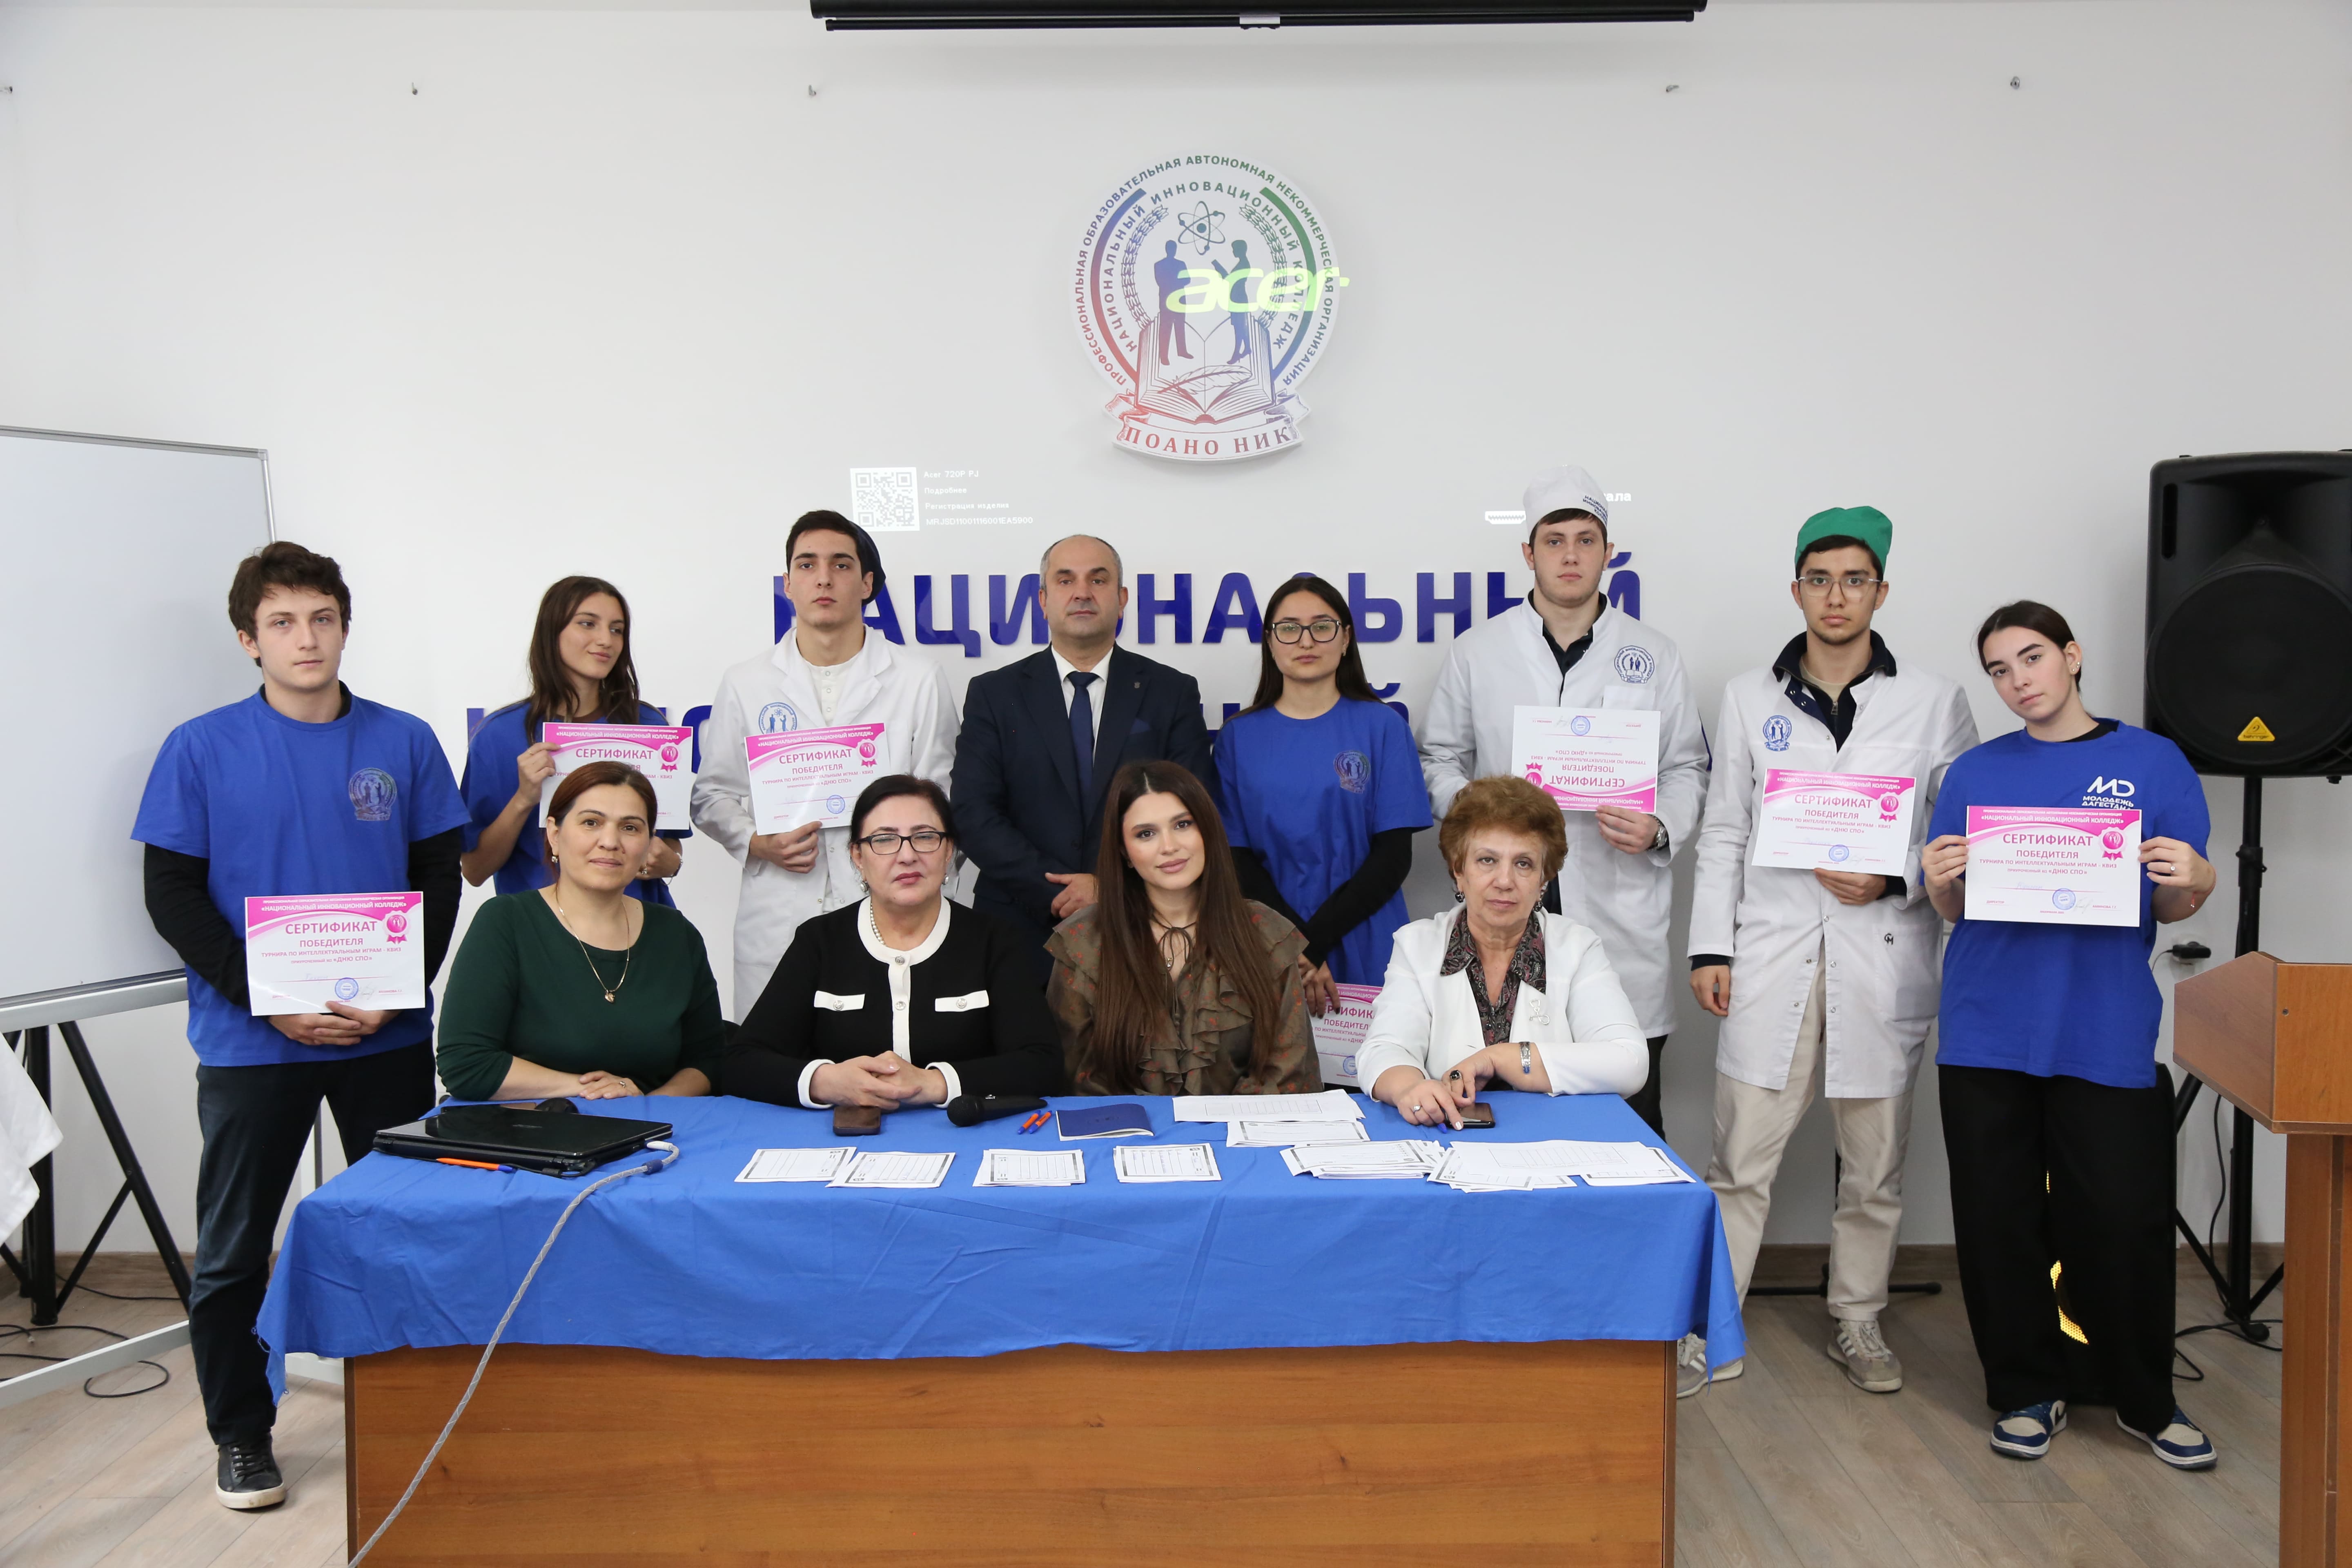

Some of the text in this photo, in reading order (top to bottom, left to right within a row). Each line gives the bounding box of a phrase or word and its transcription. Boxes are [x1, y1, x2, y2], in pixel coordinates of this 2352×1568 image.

[1075, 155, 1334, 386] ПРОФЕССИОНАЛЬНАЯ ОБРАЗОВАТЕЛЬНАЯ АВТОНОМНАЯ НЕКОММЕРЧЕСКАЯ ОРГАНИЗАЦИЯ
[1104, 181, 1304, 352] НАЦИОНАЛЬНЫЙ ИННОВАЦИОННЫЙ КОЛЛЕДЖ
[1165, 267, 1350, 314] acer
[1124, 425, 1291, 455] ПОАНО НИК
[758, 737, 802, 746] «НАЦИОНАЛЬНЫЙ
[803, 733, 847, 742] ИННОВАЦИОННЫЙ
[576, 748, 653, 759] СЕРТИФИКАТ
[779, 748, 852, 764] СЕРТИФИКАТ
[792, 764, 843, 774] ПОБЕДИТЕЛЯ
[1562, 764, 1614, 773] ПОБЕДИТЕЛЯ
[1550, 775, 1625, 788] СЕРТИФИКАТ
[1795, 794, 1873, 809] СЕРТИФИКАТ
[2083, 795, 2134, 807] МОЛОДЕЖЬ
[1804, 809, 1859, 819] ПОБЕДИТЕЛЯ
[1803, 818, 1855, 826] ИНТЕЛЛЕКТУАЛЬНЫМ
[2003, 833, 2093, 846] СЕРТИФИКАТ
[2016, 850, 2078, 859] ПОБЕДИТЕЛЯ
[317, 902, 373, 910] ИННОВАЦИОННЫЙ
[285, 921, 377, 934] СЕРТИФИКАТ
[300, 938, 363, 948] ПОБЕДИТЕЛЯ
[1324, 1019, 1370, 1030] ПОБЕДИТЕЛ
[1323, 1028, 1366, 1037] ИНТЕЛЛЕКТУАЛЬНЫ
